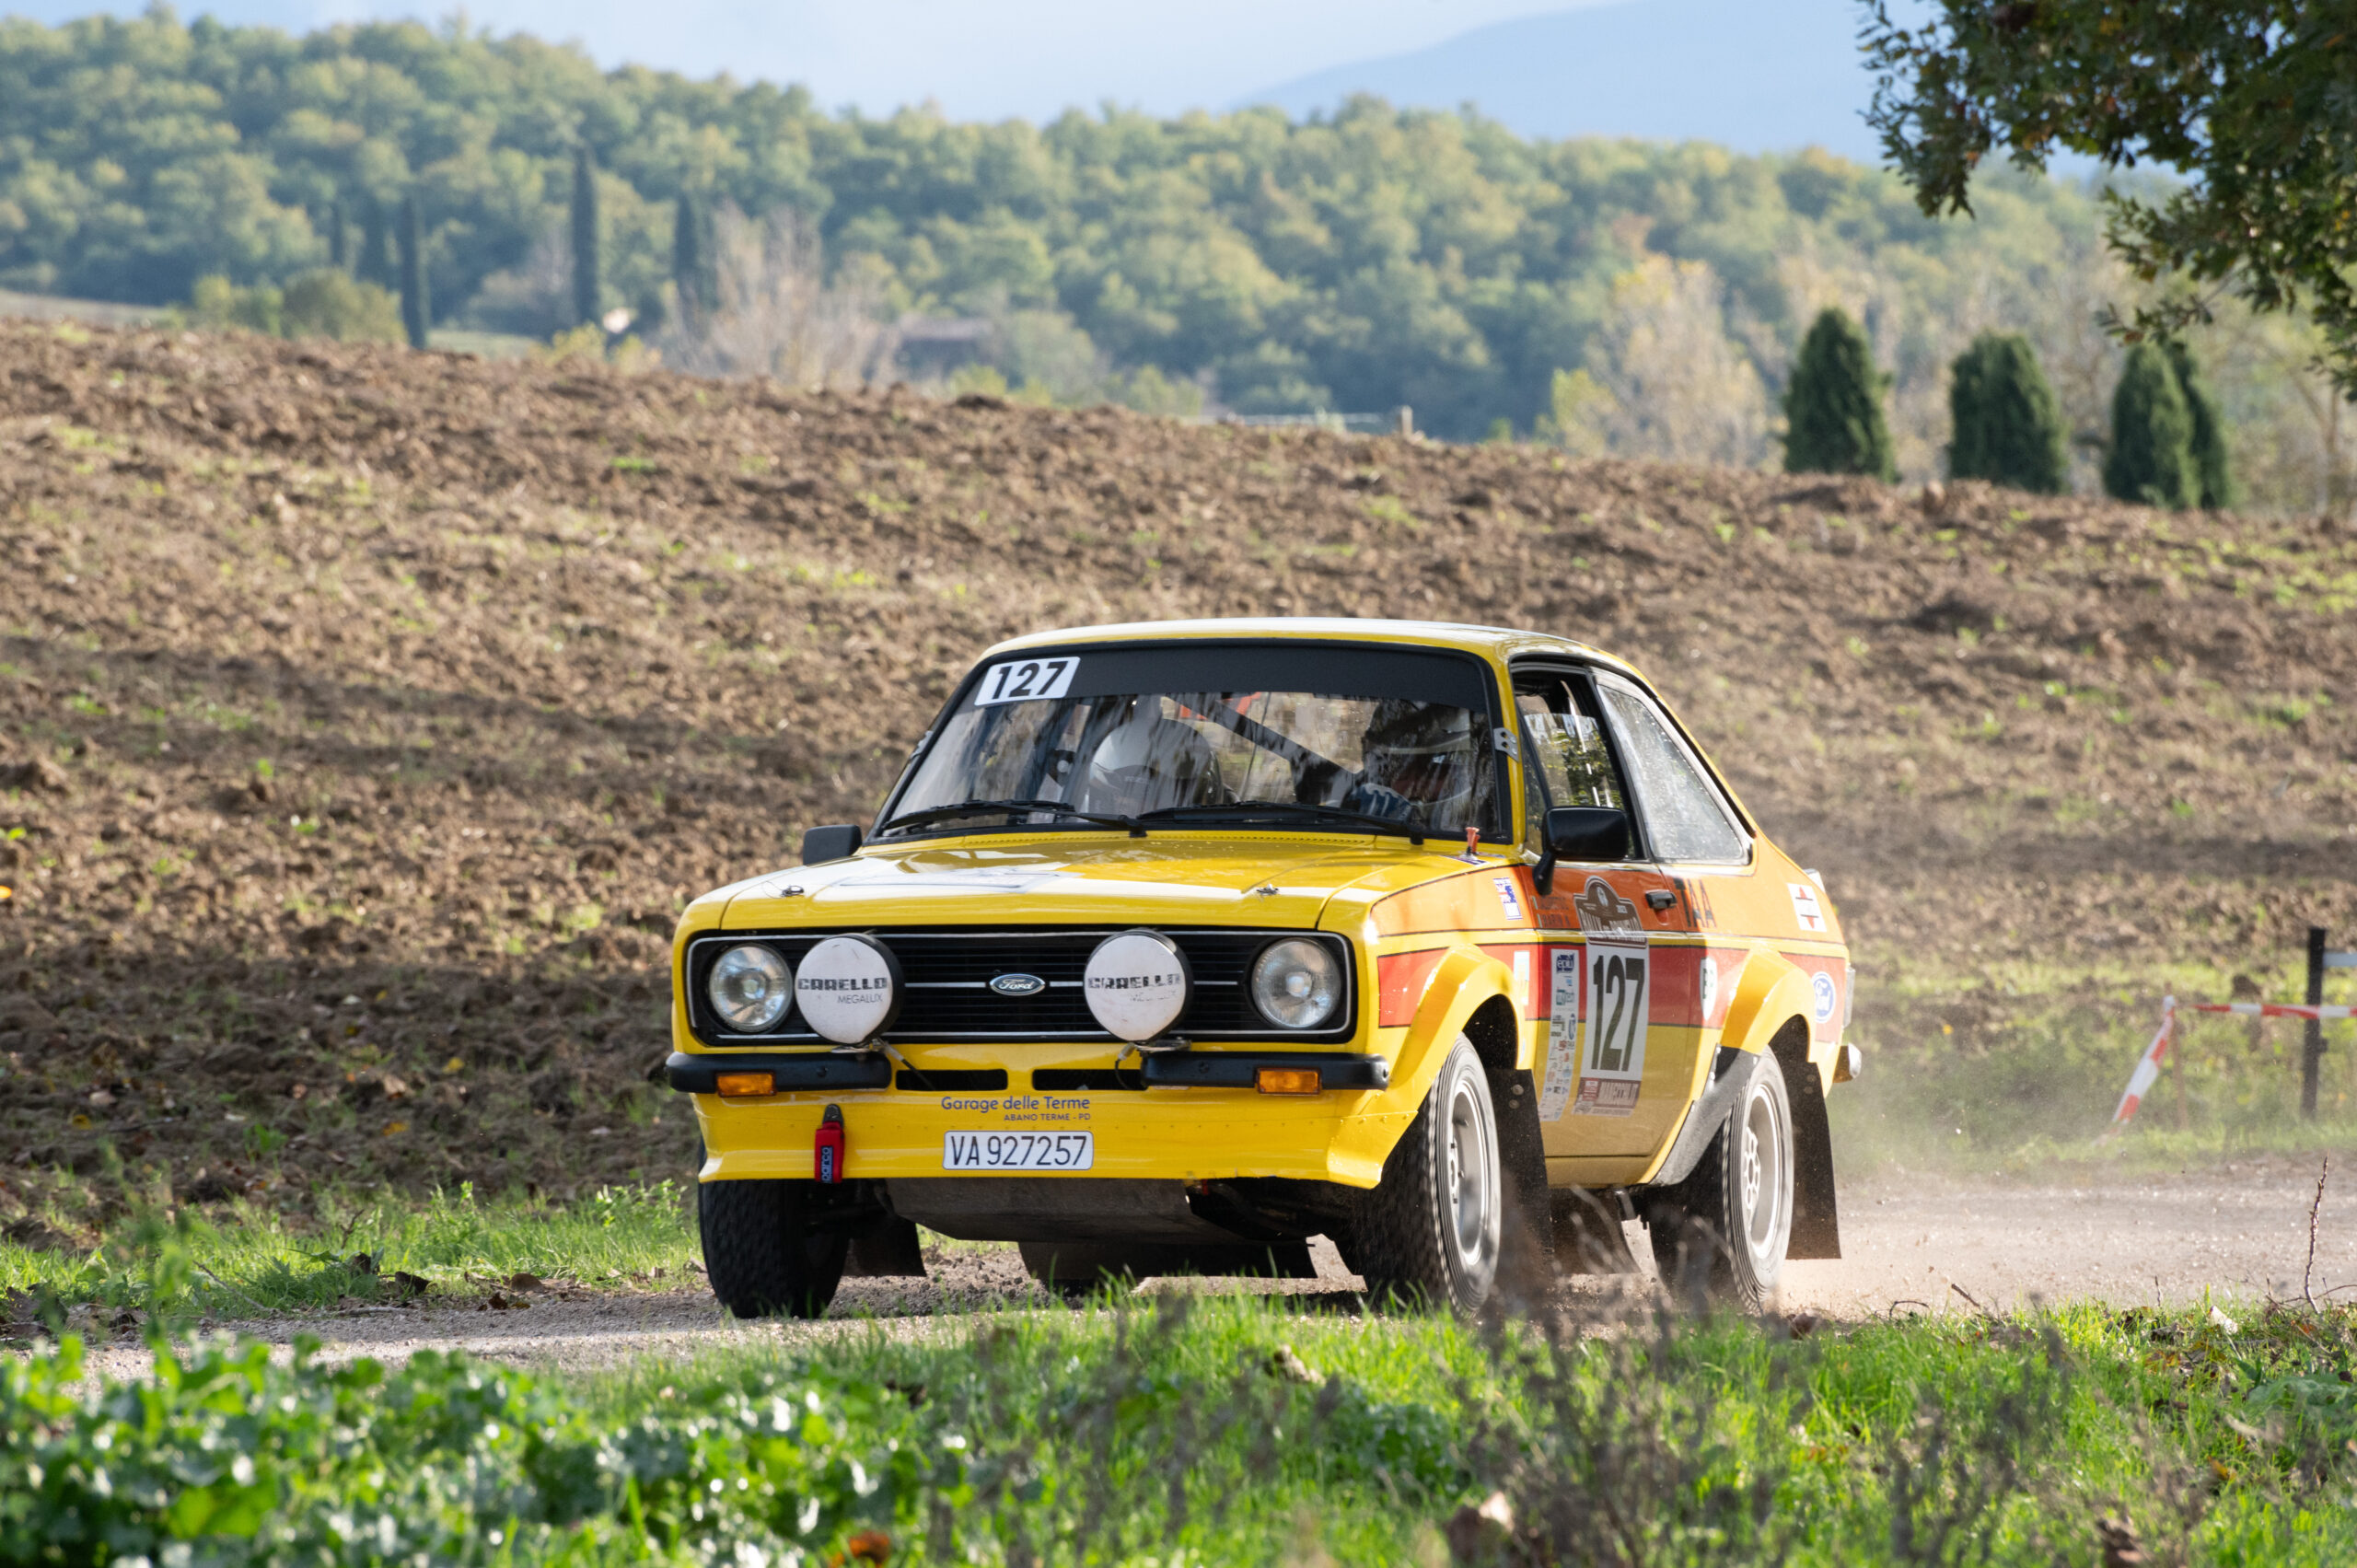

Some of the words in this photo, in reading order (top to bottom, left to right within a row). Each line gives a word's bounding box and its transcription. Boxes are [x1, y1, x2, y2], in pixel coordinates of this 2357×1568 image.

[992, 660, 1068, 699] 127
[797, 977, 888, 991] CARELLO
[998, 978, 1034, 991] Ford
[837, 993, 884, 1005] MEGALUX
[1591, 954, 1646, 1074] 127
[941, 1096, 998, 1113] Garage
[1002, 1096, 1039, 1110] delle
[1044, 1096, 1091, 1110] Terme
[1004, 1113, 1039, 1121] ABANO
[1040, 1113, 1070, 1121] TERME
[1078, 1113, 1091, 1121] PD
[821, 1146, 833, 1183] parco
